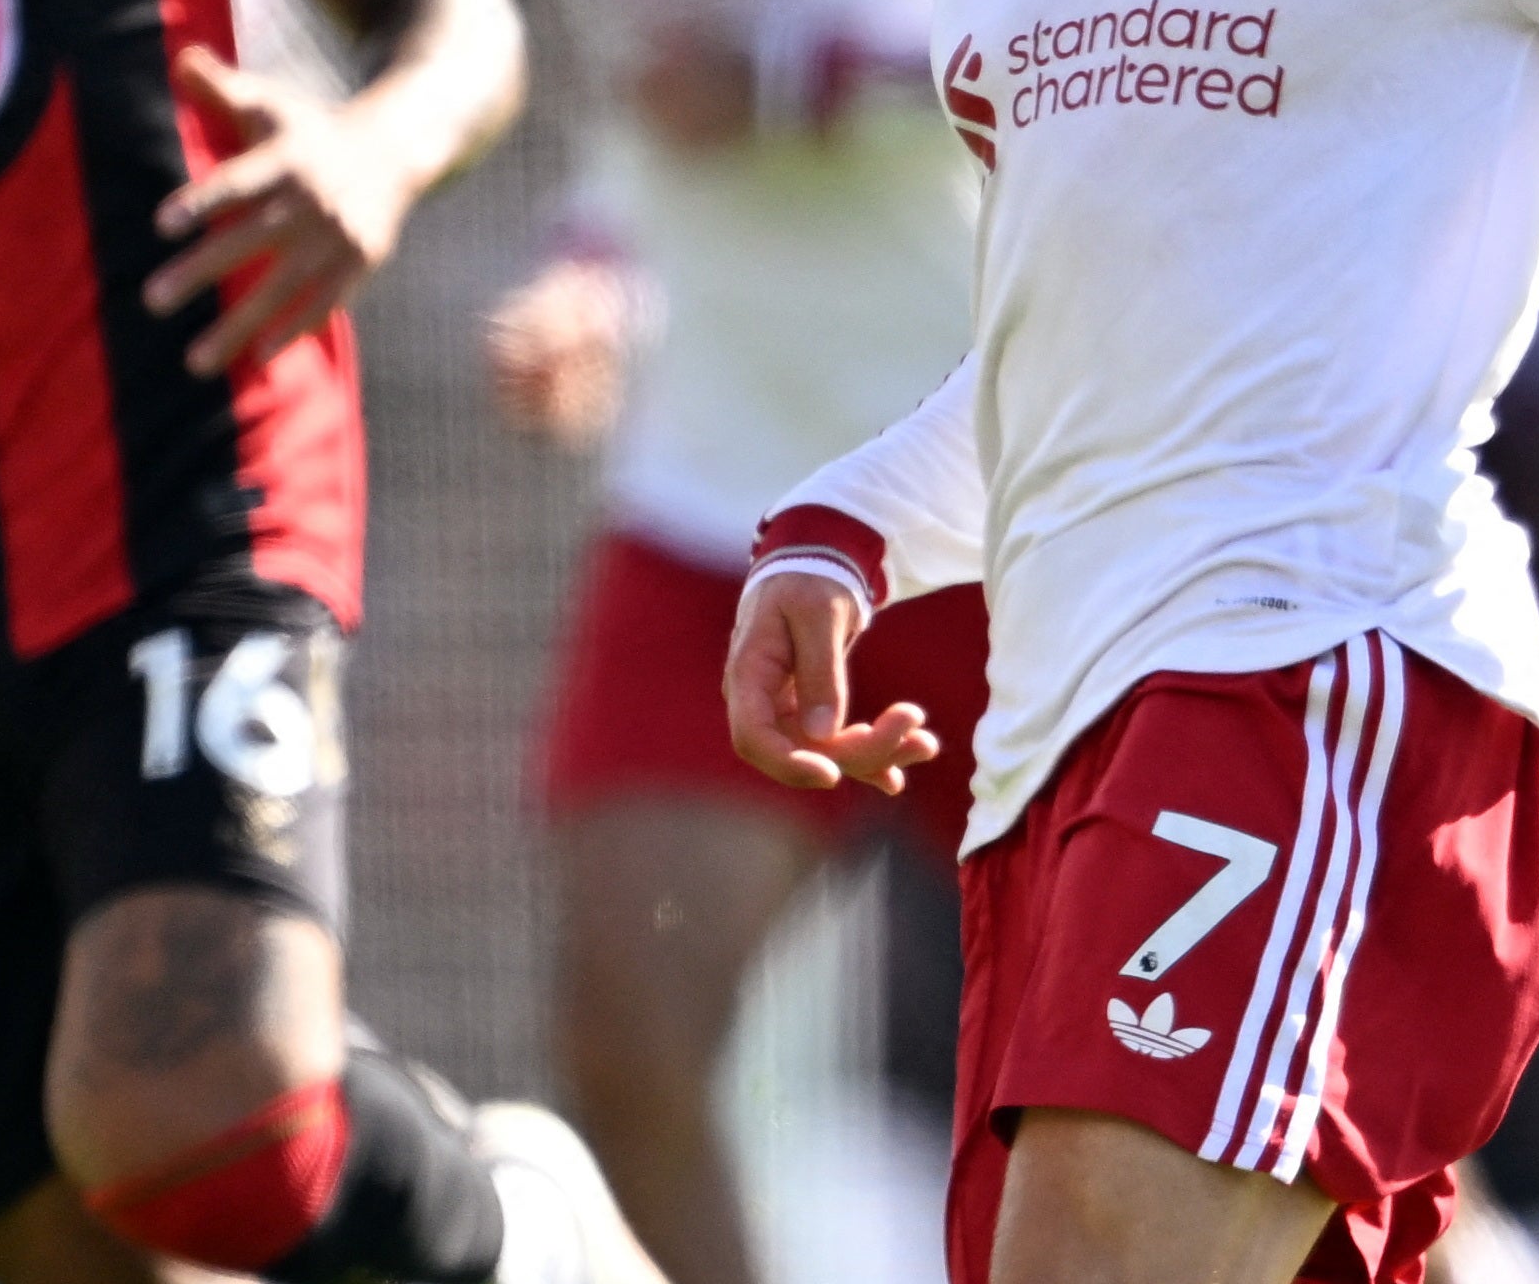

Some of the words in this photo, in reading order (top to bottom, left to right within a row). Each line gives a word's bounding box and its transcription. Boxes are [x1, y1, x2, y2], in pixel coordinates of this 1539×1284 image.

[1012, 54, 1284, 128] chartered
[127, 627, 318, 797] 16
[1117, 810, 1279, 982] 7
